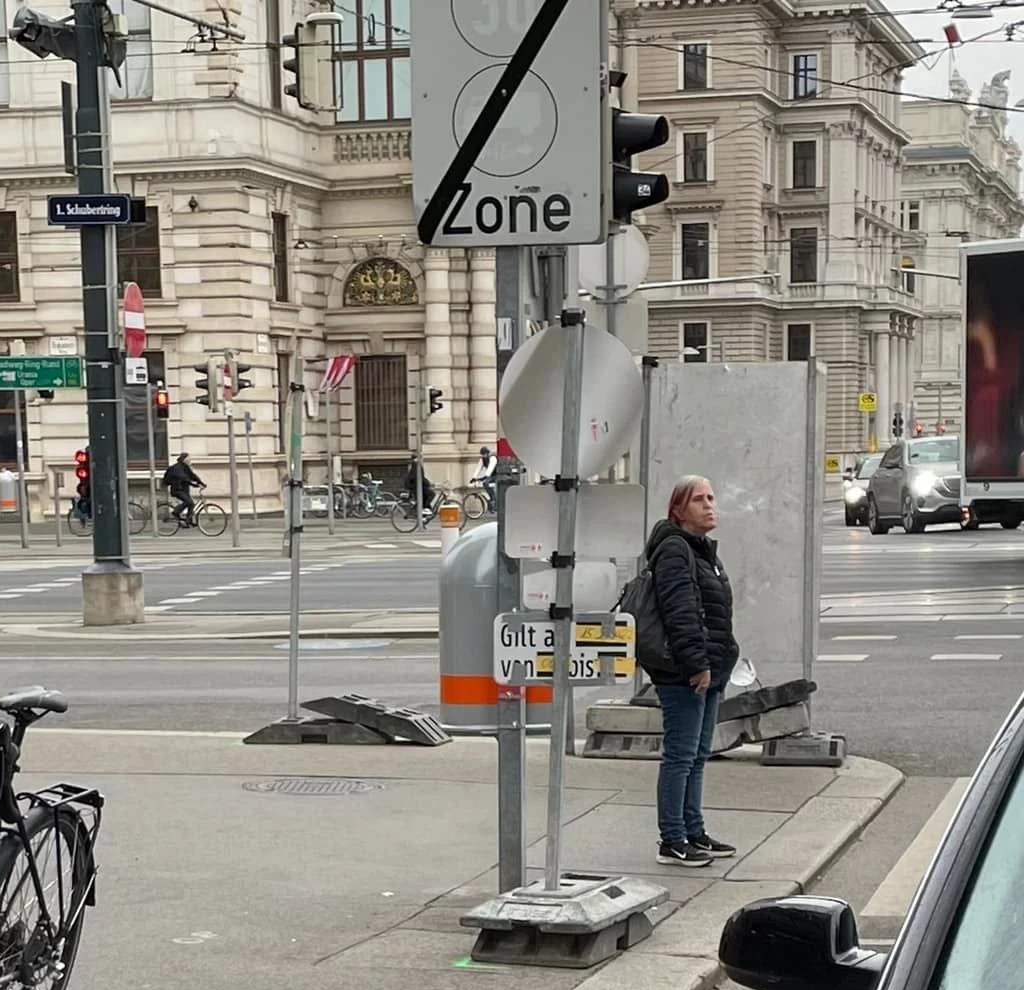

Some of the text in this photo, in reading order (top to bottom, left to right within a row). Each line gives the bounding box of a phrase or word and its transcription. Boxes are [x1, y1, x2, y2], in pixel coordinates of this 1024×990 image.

[56, 203, 121, 218] 1. Schubertring
[442, 182, 571, 235] Zone
[501, 624, 536, 648] Gilt
